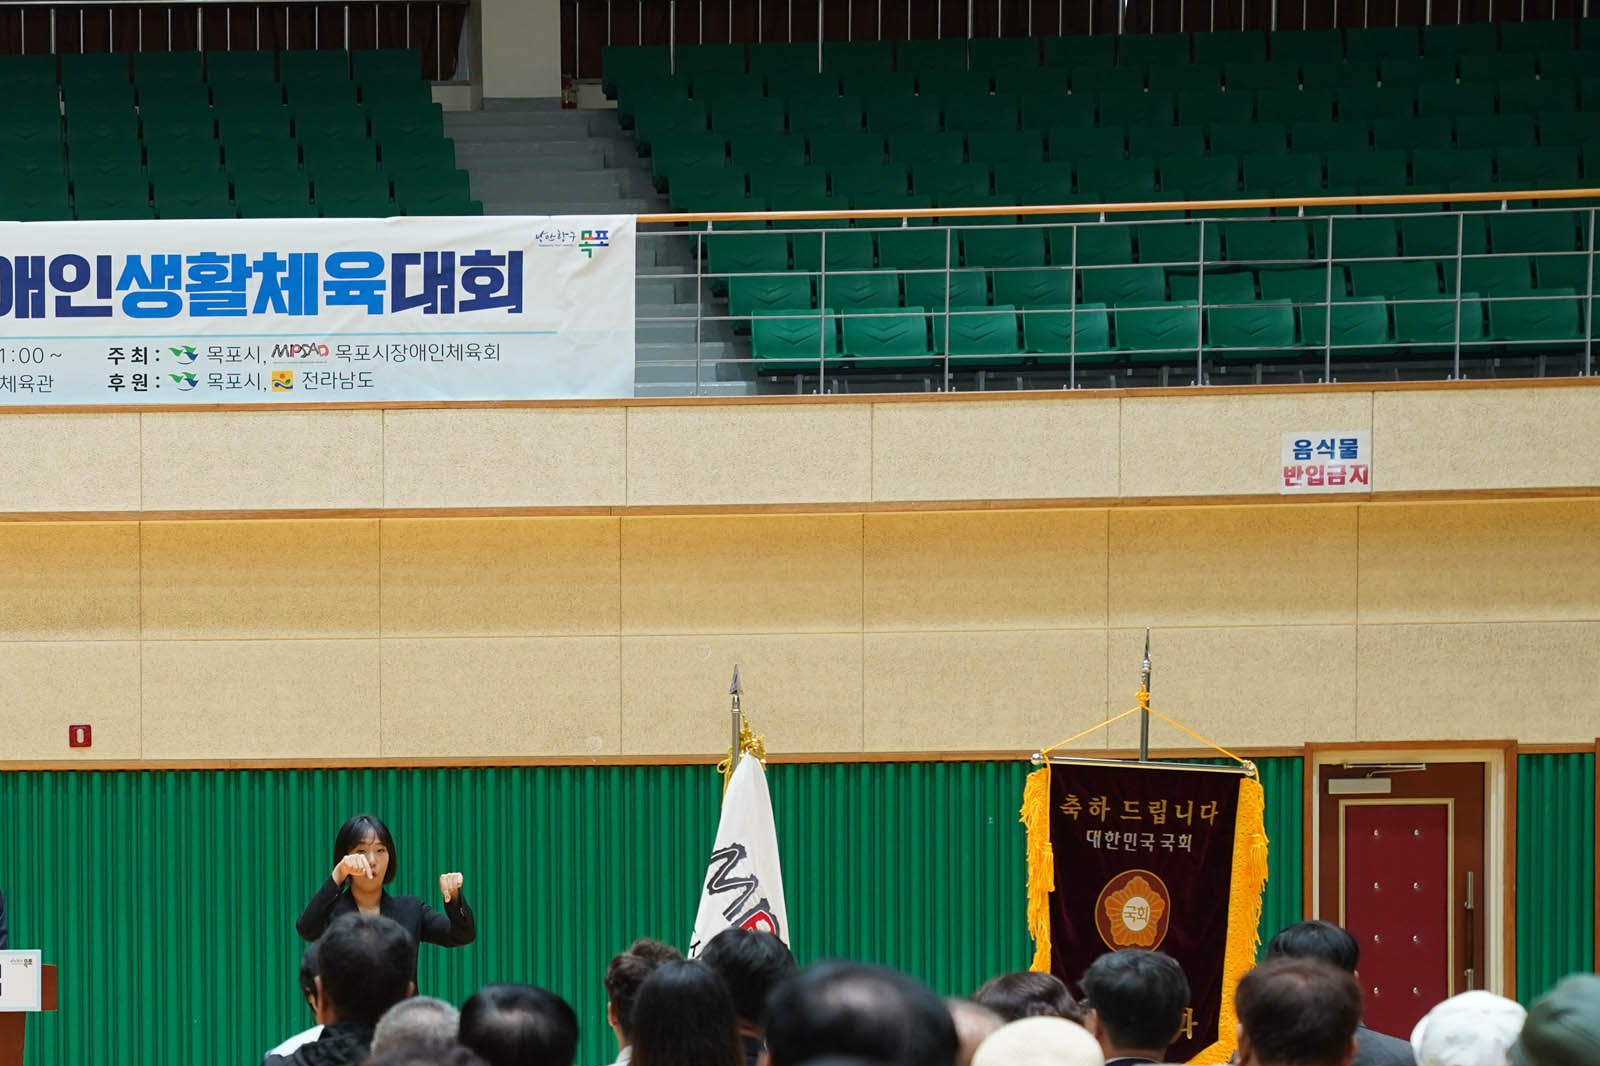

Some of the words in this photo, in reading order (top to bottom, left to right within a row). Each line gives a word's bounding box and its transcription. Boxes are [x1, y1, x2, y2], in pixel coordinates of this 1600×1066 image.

[579, 230, 609, 258] 목포
[206, 345, 267, 367] 목포시,
[271, 342, 330, 358] MPSAD
[335, 342, 500, 364] 목포시장애인체육회
[206, 371, 267, 393] 목포시,
[301, 370, 375, 391] 전라남도
[1293, 438, 1359, 460] 음식물
[1283, 464, 1369, 487] 반입금지
[1059, 794, 1111, 822] 축하
[1119, 799, 1219, 826] 드립니다
[1086, 829, 1156, 852] 대한민국
[1159, 833, 1193, 853] 국회
[1123, 905, 1149, 924] 국회
